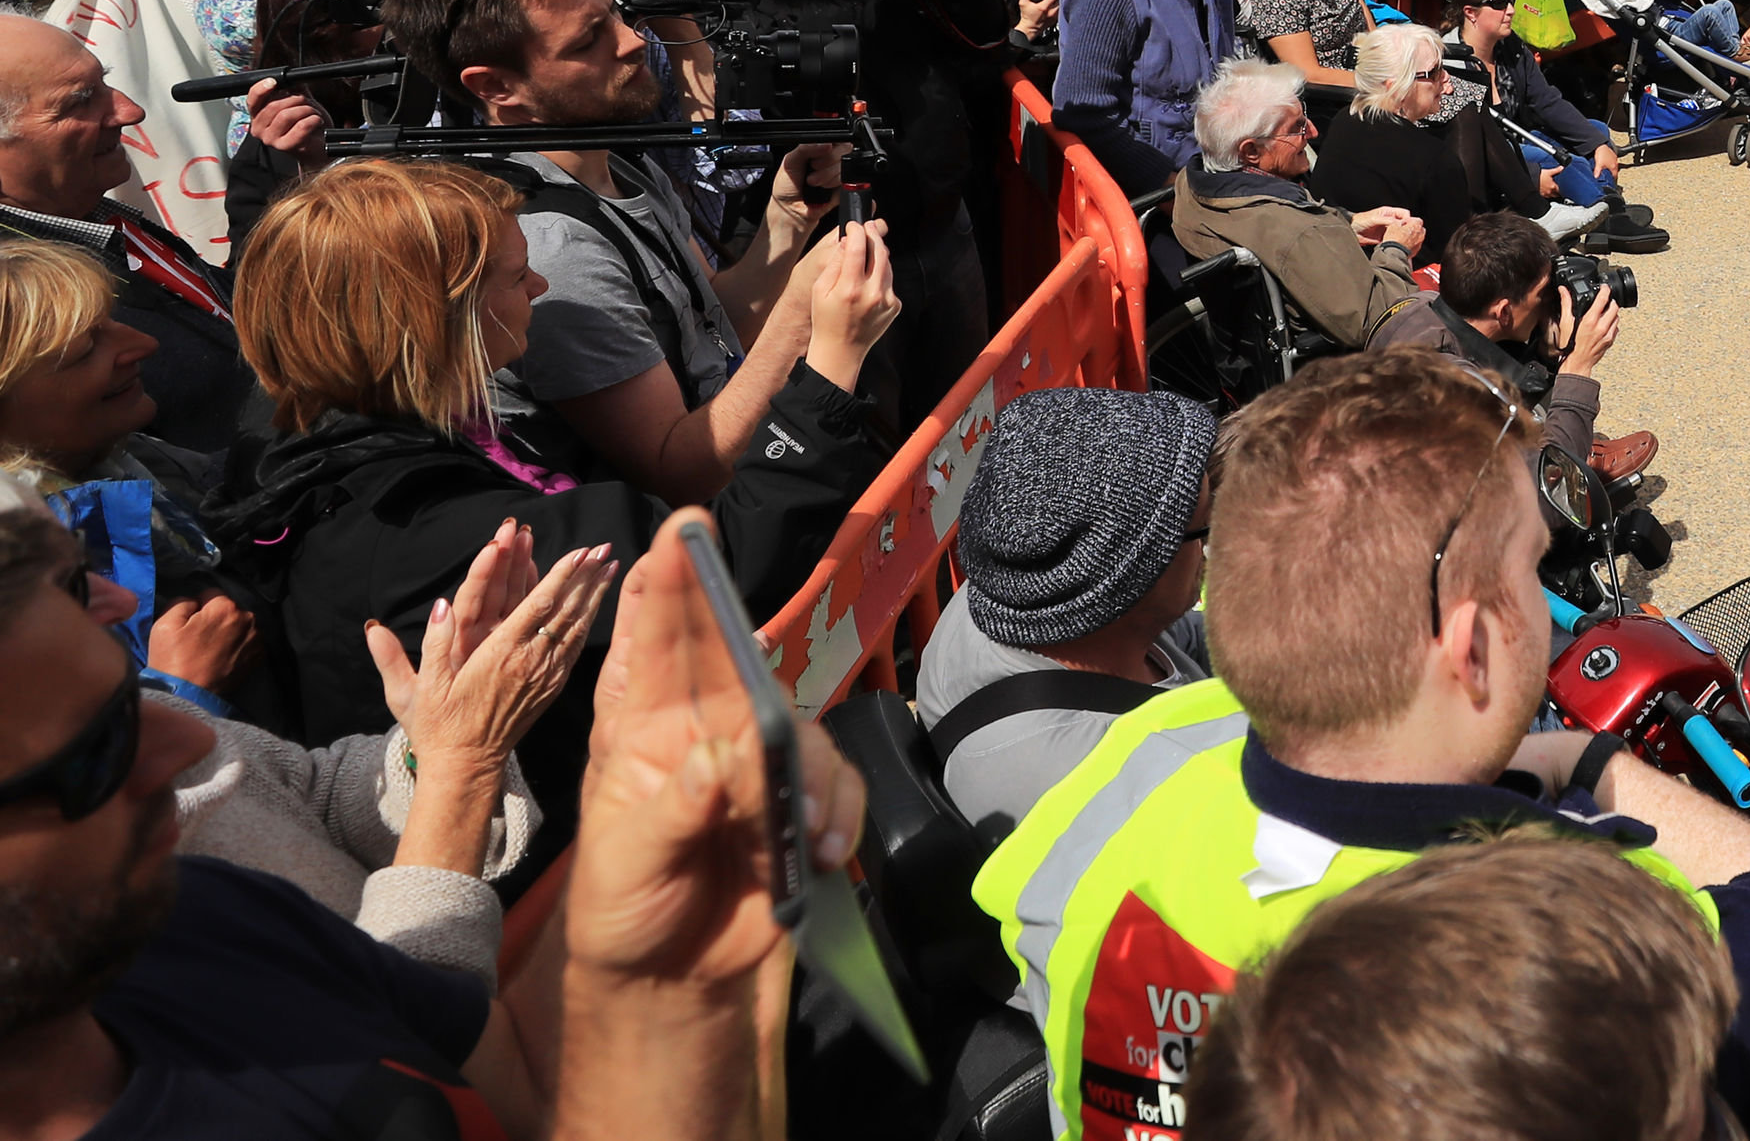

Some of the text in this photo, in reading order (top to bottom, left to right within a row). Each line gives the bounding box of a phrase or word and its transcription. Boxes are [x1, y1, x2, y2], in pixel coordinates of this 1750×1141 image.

[1146, 985, 1226, 1034] VOT
[1125, 1036, 1160, 1070] for
[1085, 1080, 1137, 1118] VOTE
[1136, 1097, 1161, 1124] for
